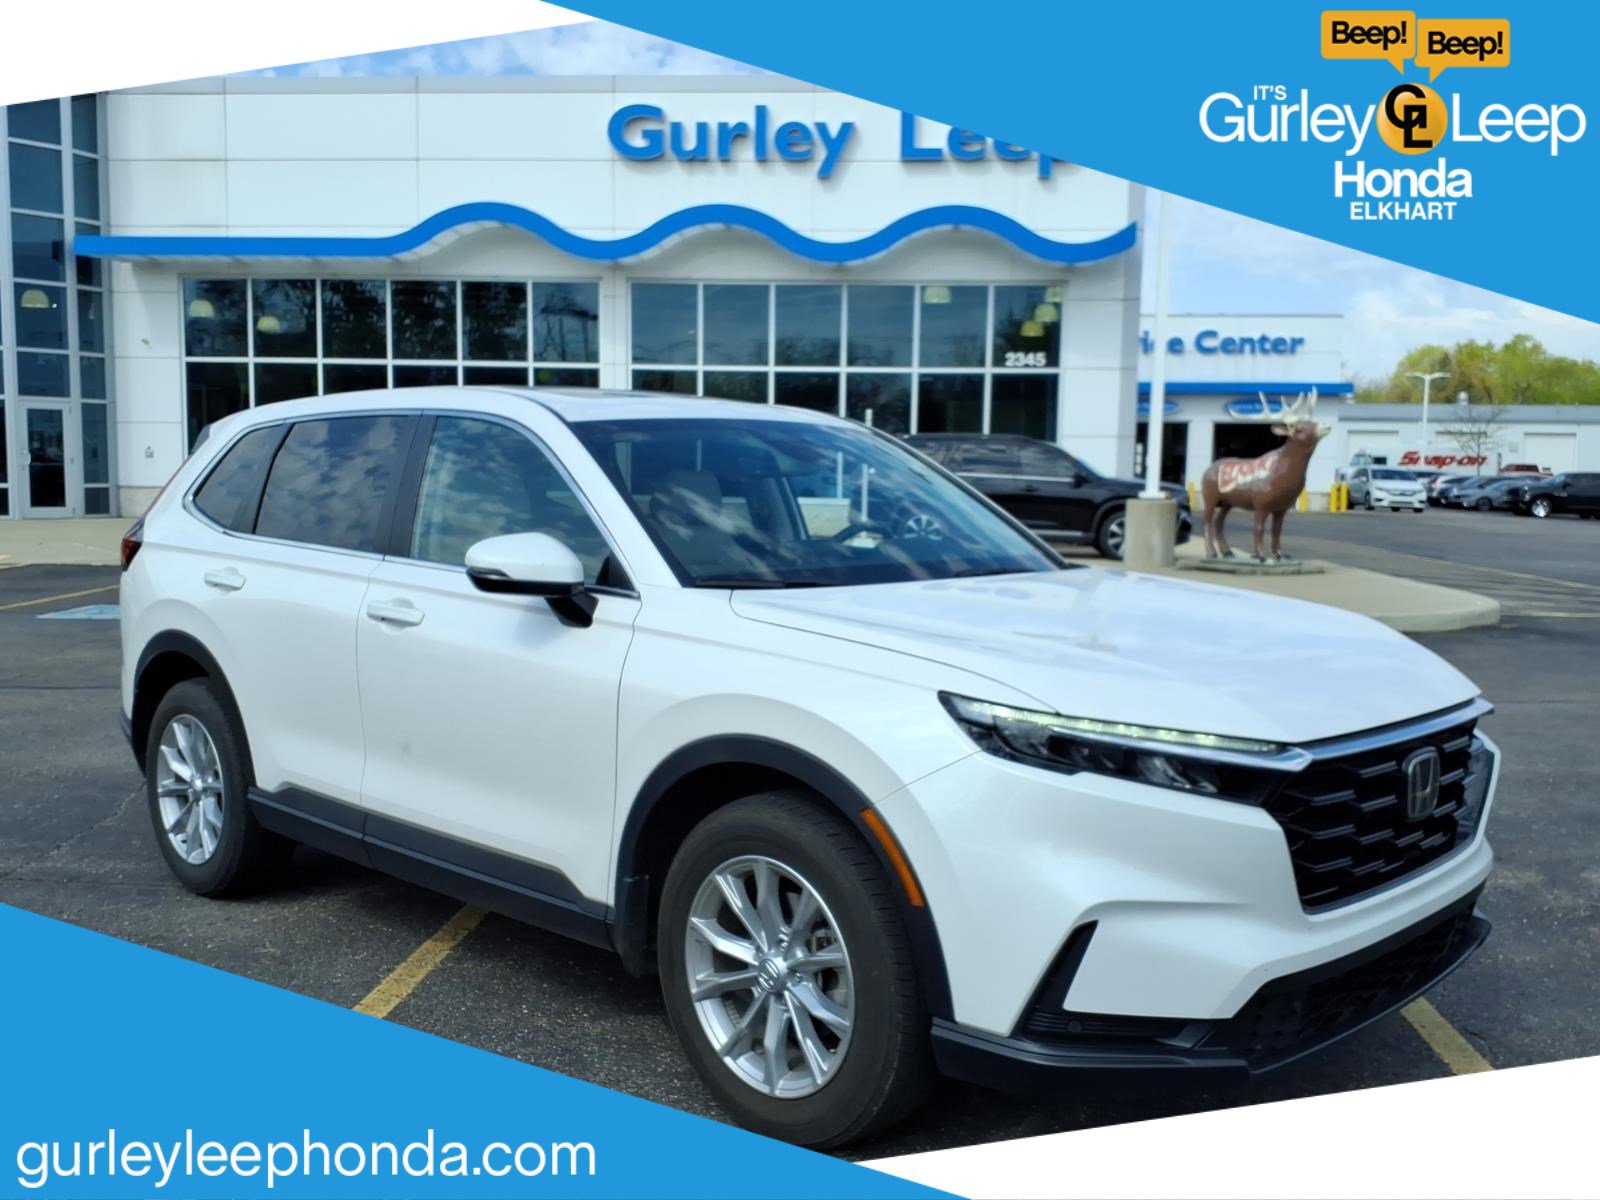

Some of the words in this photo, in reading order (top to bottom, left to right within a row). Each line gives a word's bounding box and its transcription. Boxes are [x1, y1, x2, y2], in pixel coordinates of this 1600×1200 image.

[607, 103, 855, 179] Gurley
[1194, 330, 1304, 355] Center
[1004, 351, 1047, 367] 2345
